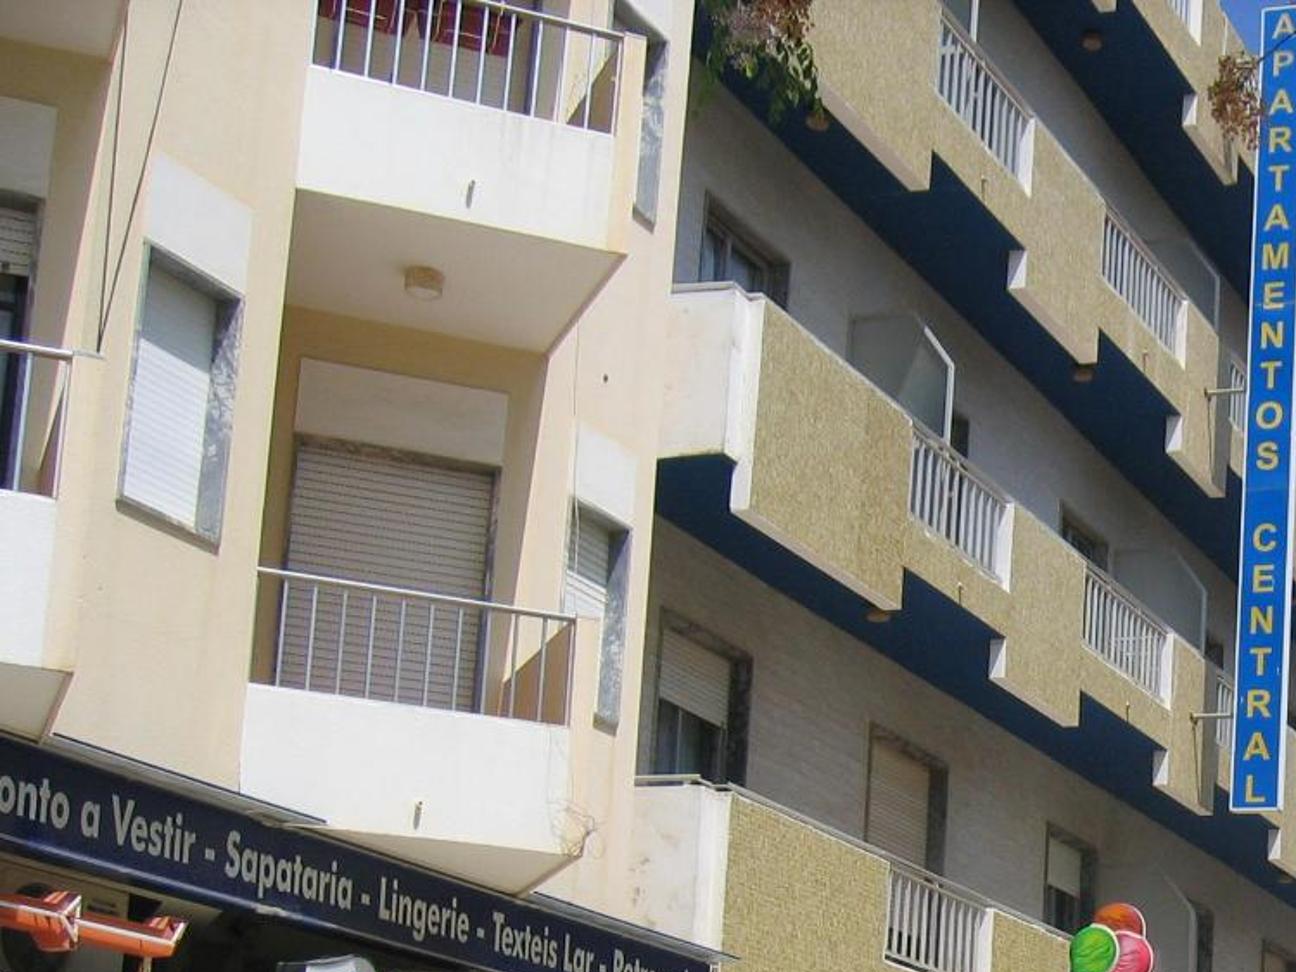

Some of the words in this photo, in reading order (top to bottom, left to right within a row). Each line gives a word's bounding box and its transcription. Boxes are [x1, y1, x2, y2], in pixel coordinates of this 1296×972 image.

[1255, 13, 1296, 471] APARTAMENTOS
[1243, 523, 1278, 803] CENTRAL
[81, 800, 101, 839] a
[112, 794, 197, 864] Vestir
[225, 831, 354, 910] Sapataria
[378, 877, 470, 943] Lingerie
[493, 911, 558, 969] Texteis
